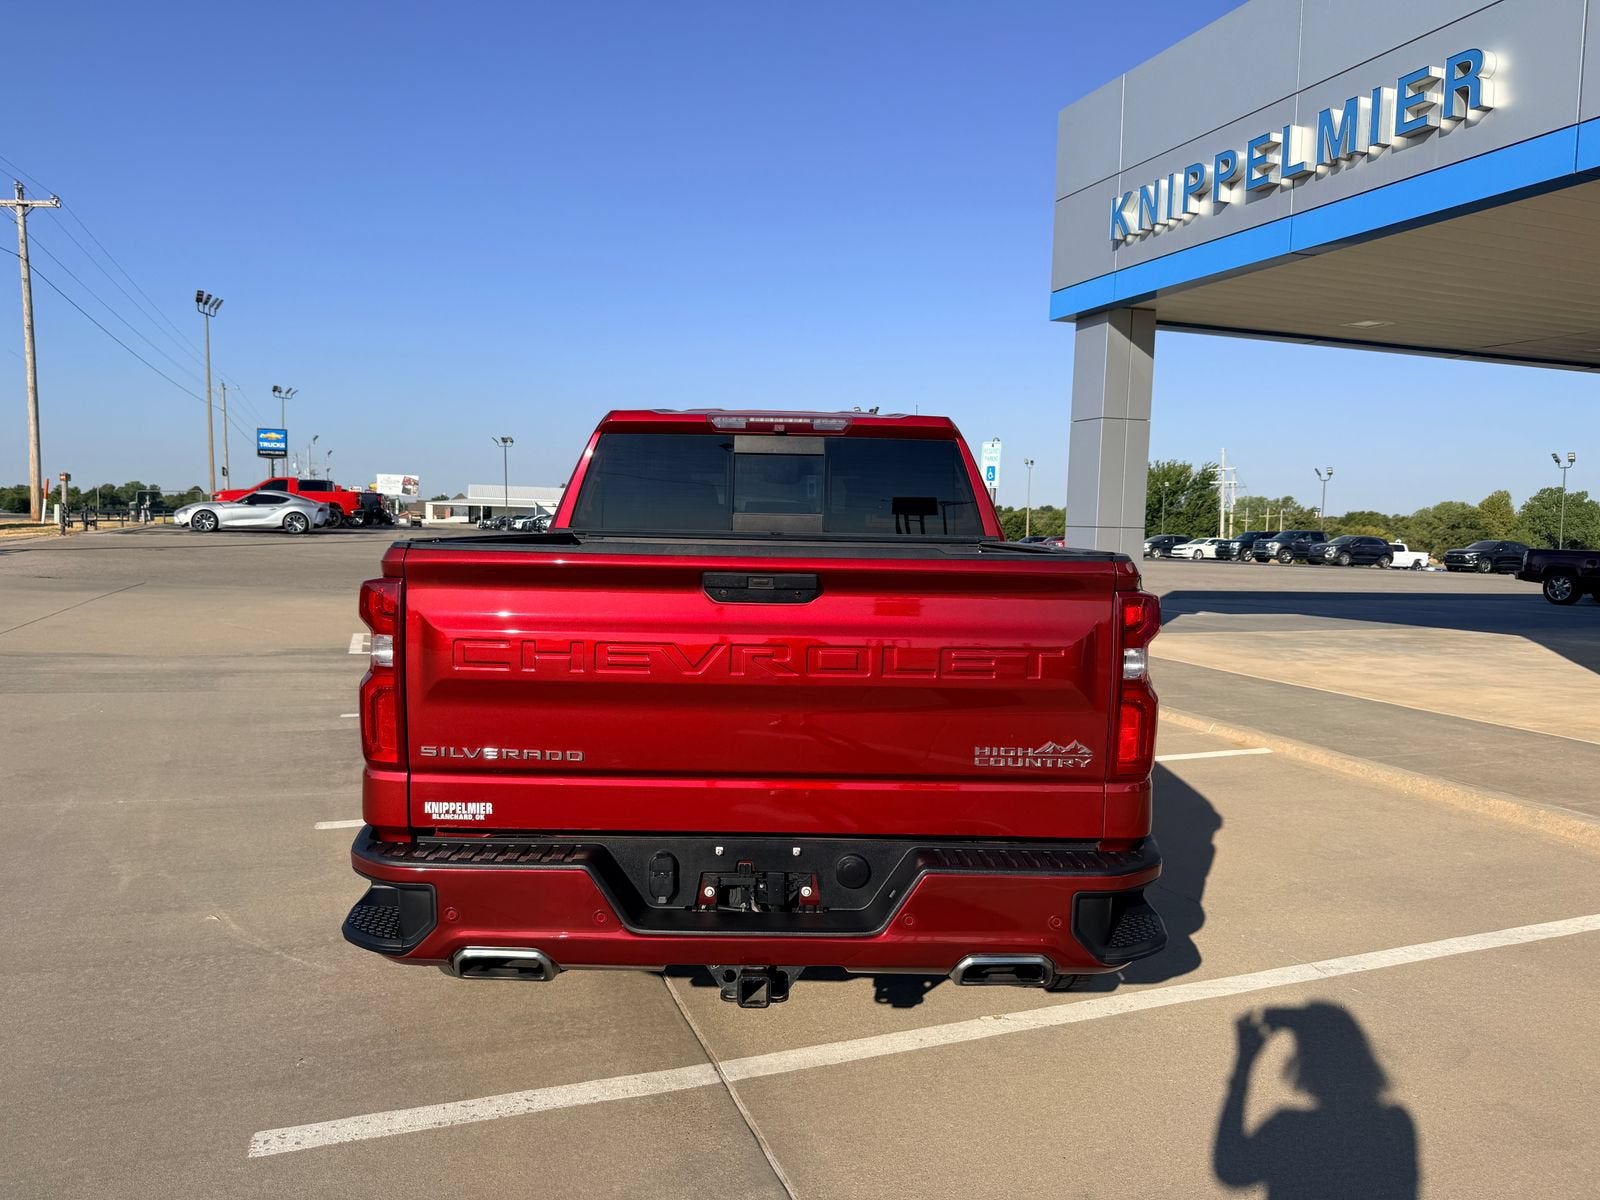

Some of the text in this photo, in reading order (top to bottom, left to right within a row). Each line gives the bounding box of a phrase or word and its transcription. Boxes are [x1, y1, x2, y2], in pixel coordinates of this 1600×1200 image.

[1110, 48, 1491, 241] KNIPPELMIER
[259, 441, 286, 449] TRUCKS
[452, 638, 1066, 679] CHEVROLET
[420, 745, 584, 762] SILVERADO
[974, 746, 1034, 756] HIGH
[974, 757, 1092, 768] COUNTRY
[424, 801, 493, 814] KNIPPELMIER
